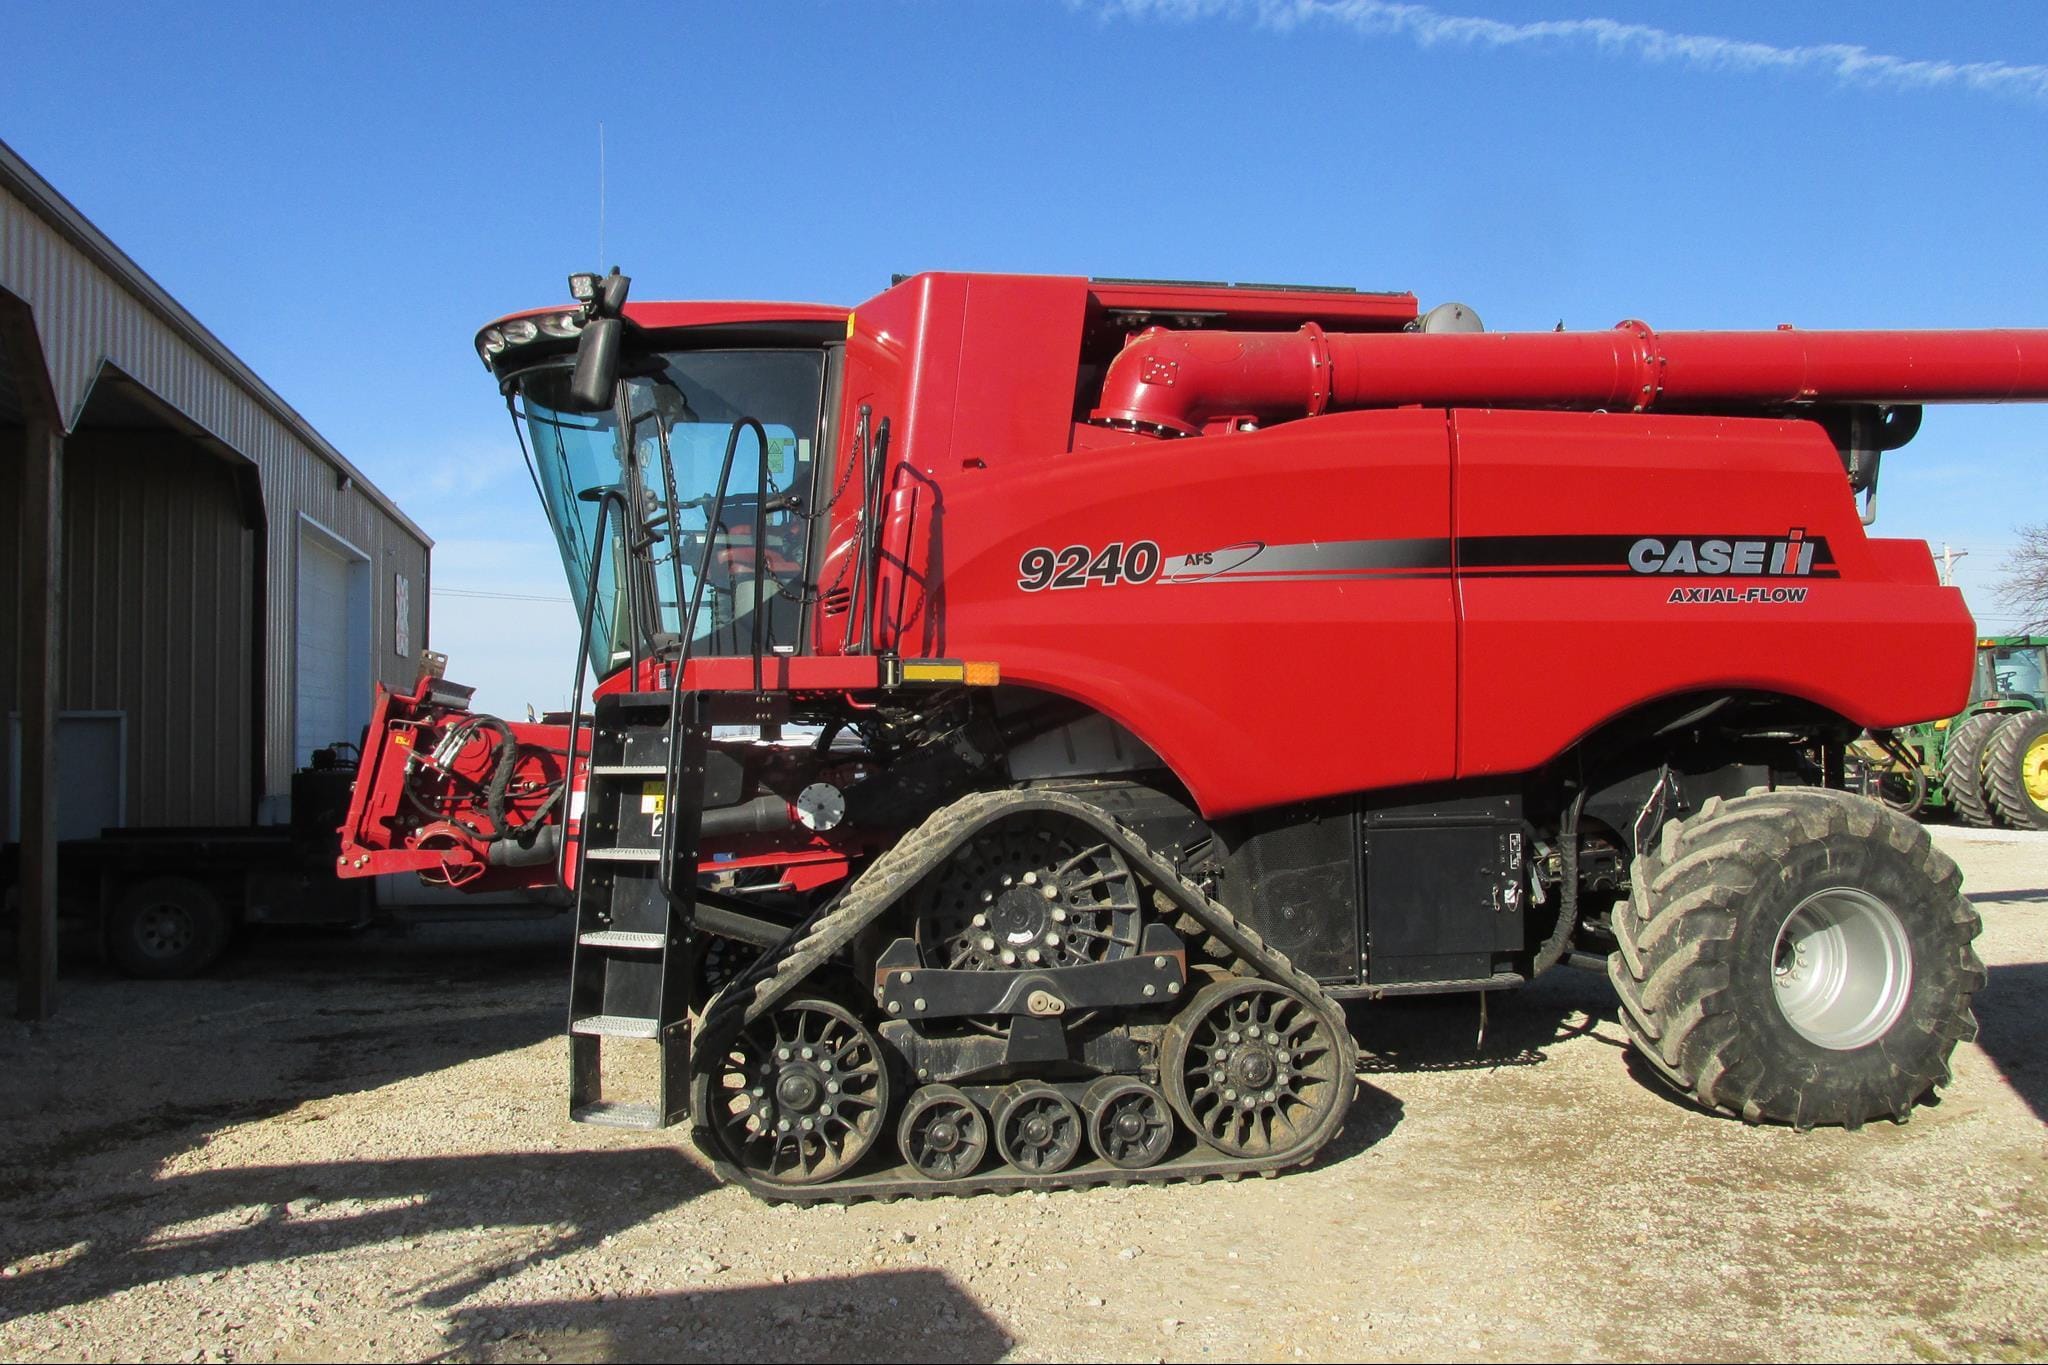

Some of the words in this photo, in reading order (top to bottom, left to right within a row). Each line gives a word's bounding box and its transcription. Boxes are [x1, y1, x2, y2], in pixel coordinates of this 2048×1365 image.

[1018, 540, 1160, 592] 9240
[1184, 552, 1214, 566] AFS
[1667, 587, 1808, 604] AXIAL-FLOW
